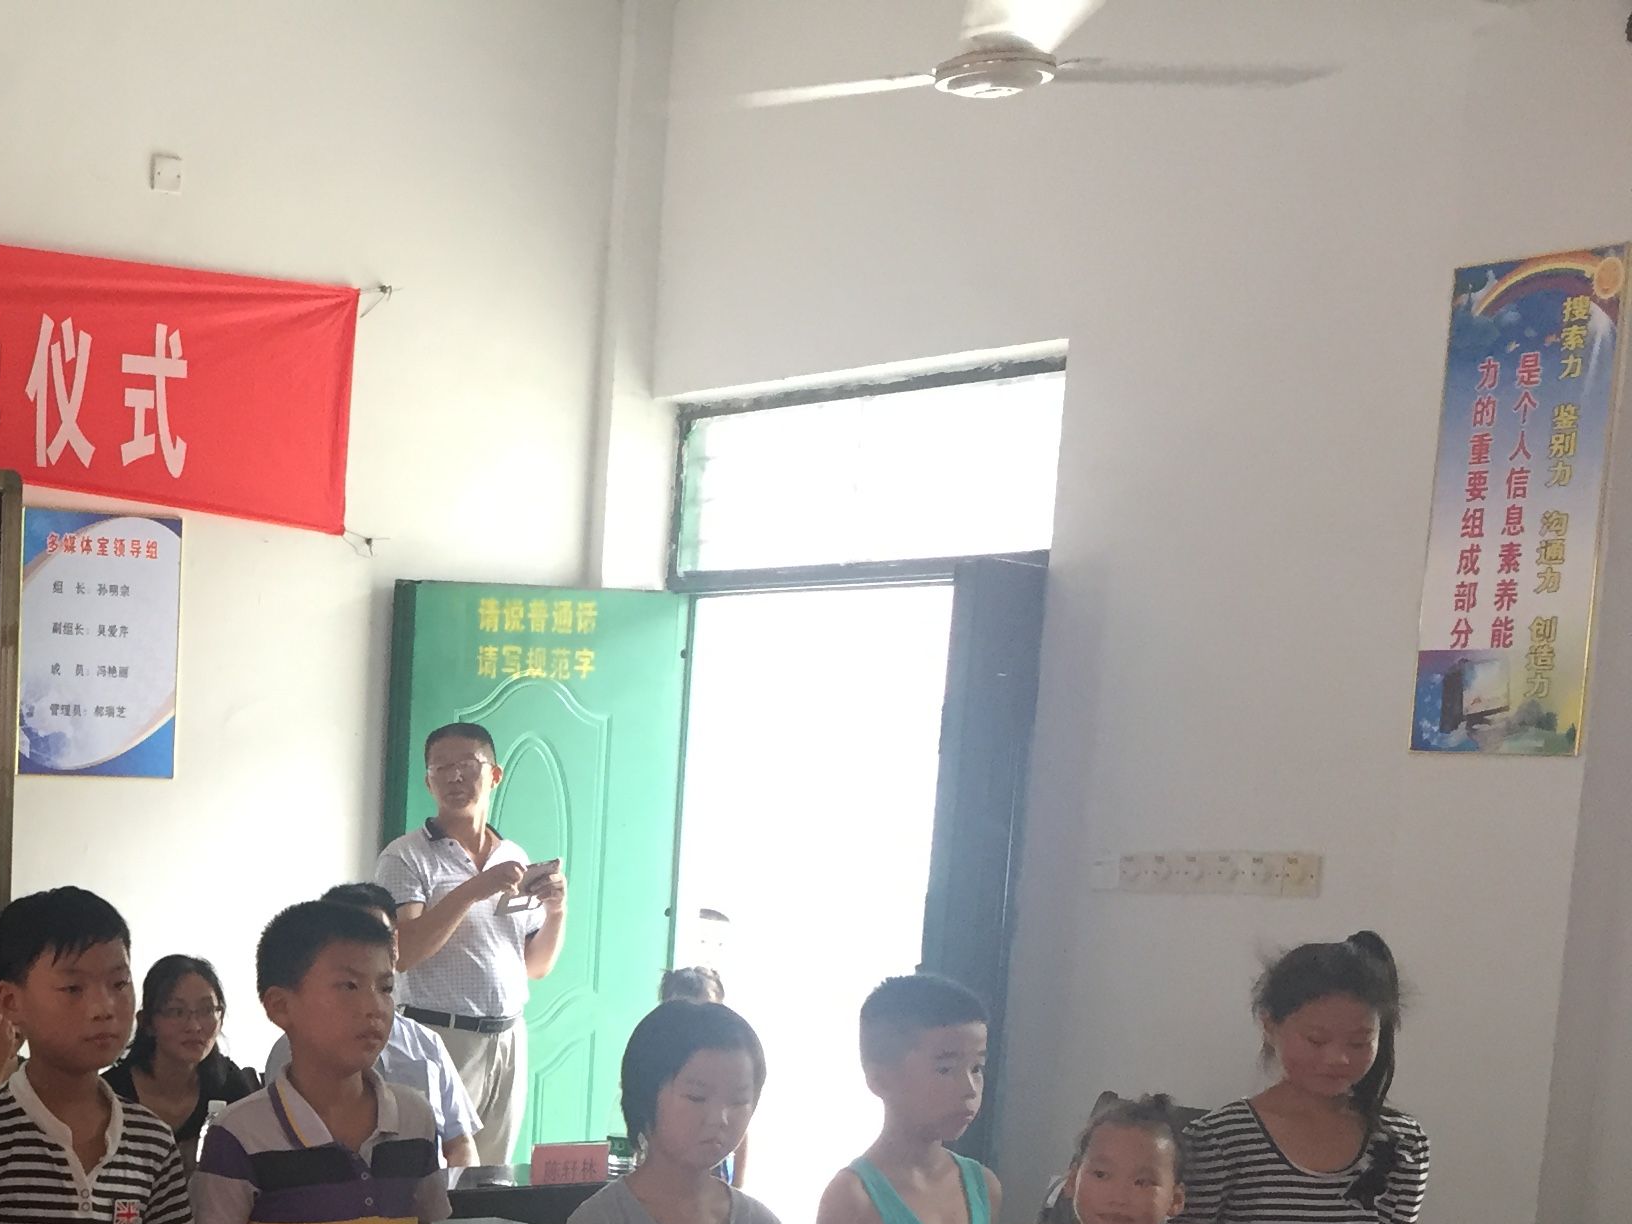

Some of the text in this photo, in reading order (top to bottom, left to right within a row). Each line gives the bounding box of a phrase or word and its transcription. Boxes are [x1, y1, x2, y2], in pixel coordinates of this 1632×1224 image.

[46, 533, 159, 560] 多媒体室领导组
[1449, 356, 1500, 650] 力的重要组成部分
[1490, 351, 1541, 650] 是个人信息素养能
[1524, 296, 1590, 699] 搜索力 鉴别力 沟通力 创造力
[477, 645, 595, 680] 请写规范字
[478, 598, 598, 634] 请说普通话
